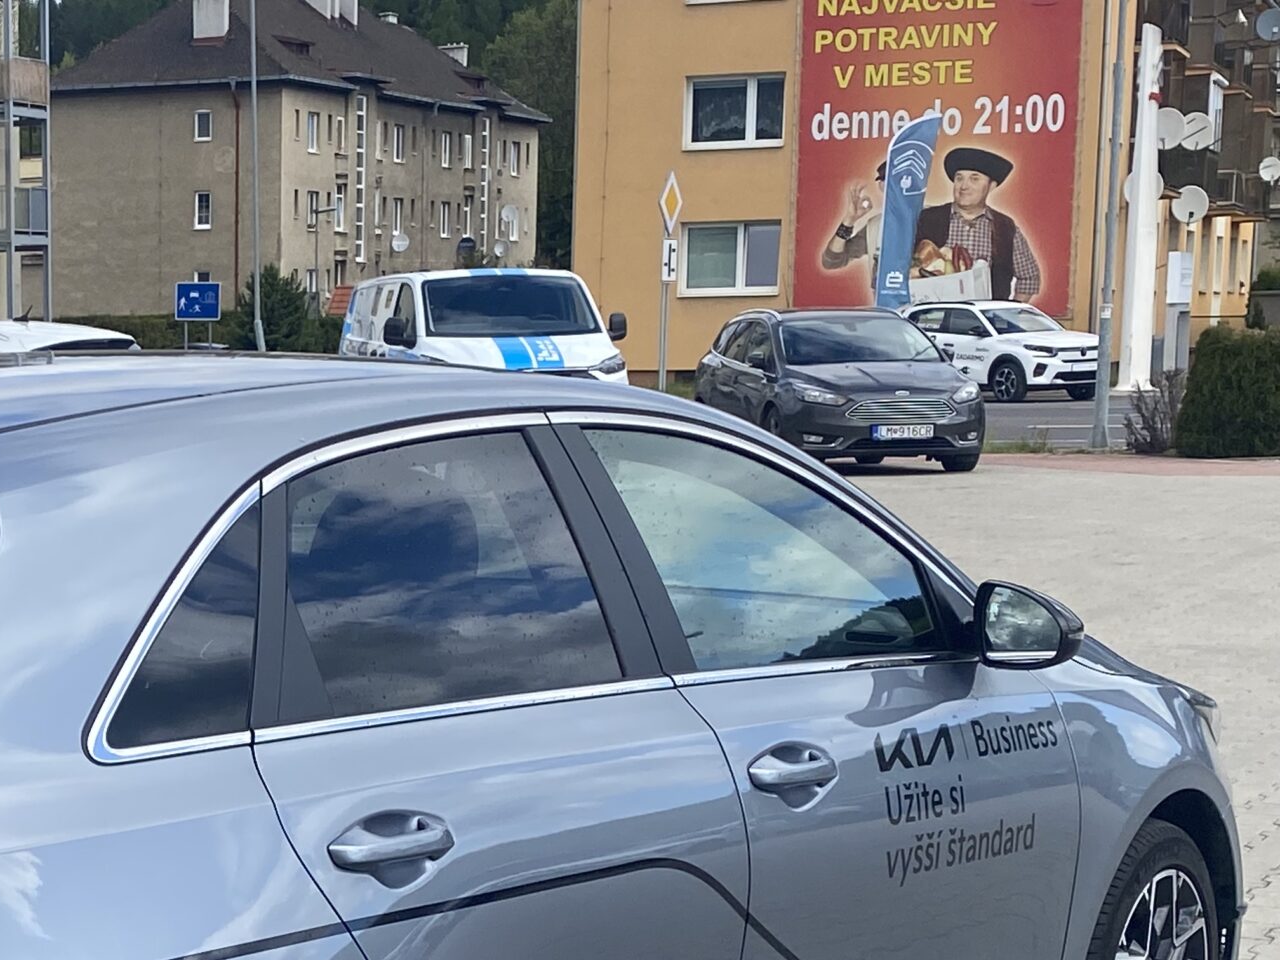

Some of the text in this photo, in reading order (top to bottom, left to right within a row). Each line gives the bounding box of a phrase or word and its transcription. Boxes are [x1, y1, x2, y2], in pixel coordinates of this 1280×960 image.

[814, 21, 998, 53] POTRAVINY
[833, 60, 973, 89] V MESTE
[811, 103, 910, 141] denne
[973, 93, 1065, 136] 21:00
[874, 715, 1058, 773] KIA Business
[884, 774, 966, 826] Užite si
[886, 813, 1036, 888] vyšší štandard
